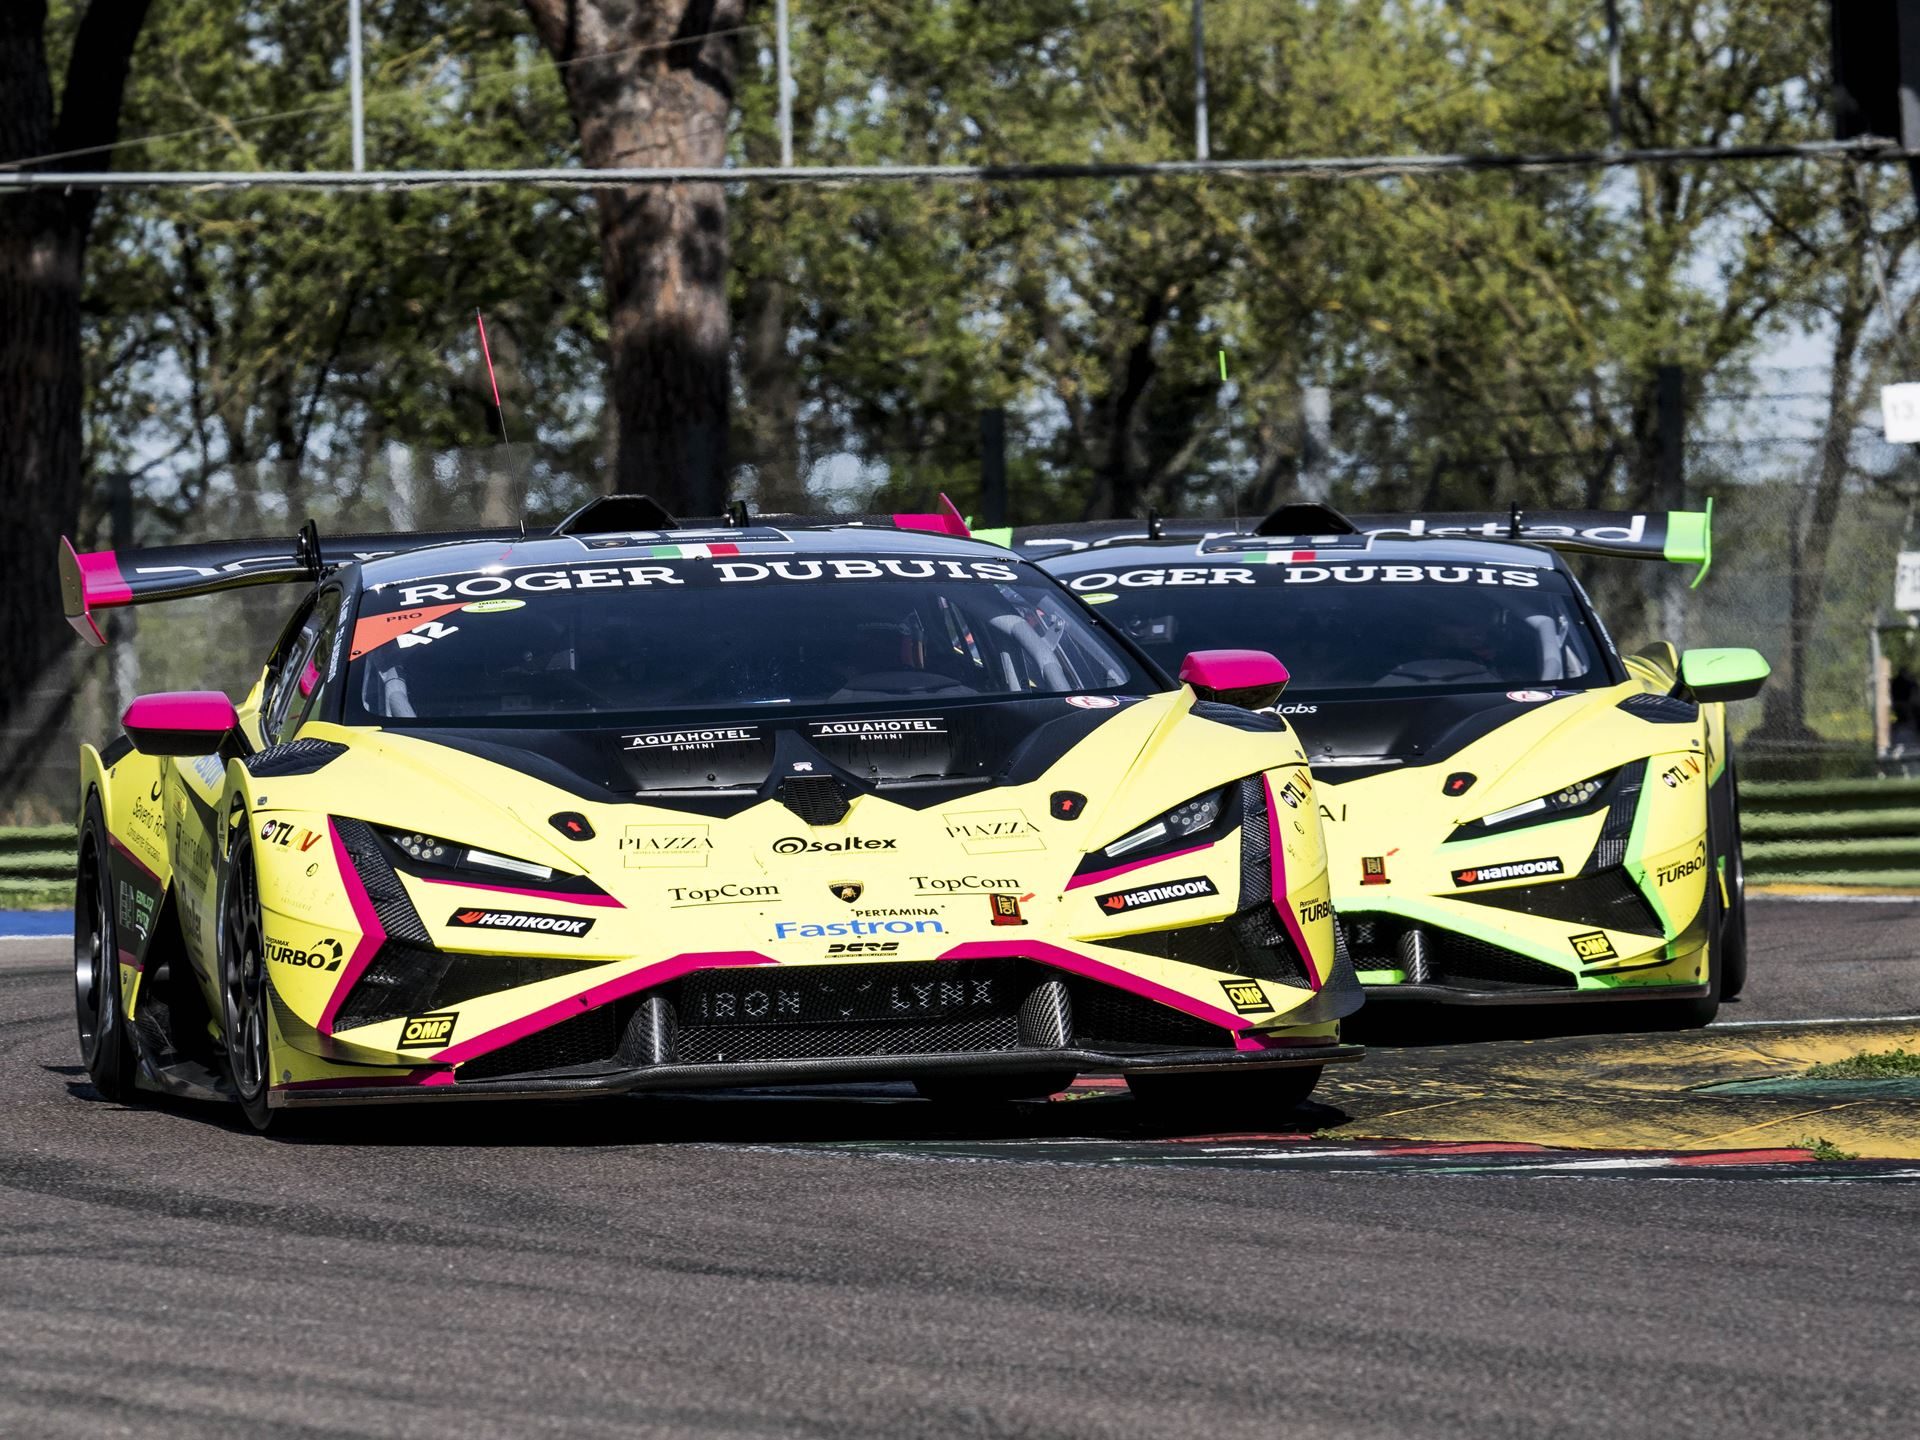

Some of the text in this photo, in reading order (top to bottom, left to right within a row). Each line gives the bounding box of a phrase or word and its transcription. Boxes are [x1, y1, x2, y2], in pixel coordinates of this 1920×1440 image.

[399, 560, 1018, 606] ROGER DUBUIS
[1062, 566, 1539, 590] OGER DUBUIS
[386, 612, 423, 623] PRO
[821, 720, 937, 735] AQUAHOTEL
[632, 730, 750, 746] AQUAHOTEL
[672, 743, 715, 751] RIMINI
[946, 822, 1040, 837] PIAZZA
[619, 837, 714, 850] PIAZZA
[1657, 857, 1702, 887] TURBO
[909, 876, 1020, 891] TopCom
[667, 884, 779, 901] TopCom
[855, 908, 939, 917] PERTAMINA
[775, 920, 943, 939] Fastron
[1576, 938, 1609, 956] OMP
[265, 943, 325, 968] TURBO
[701, 979, 992, 1018] IRON LYNX
[1229, 988, 1263, 1004] OMP
[406, 1020, 452, 1039] OMP
